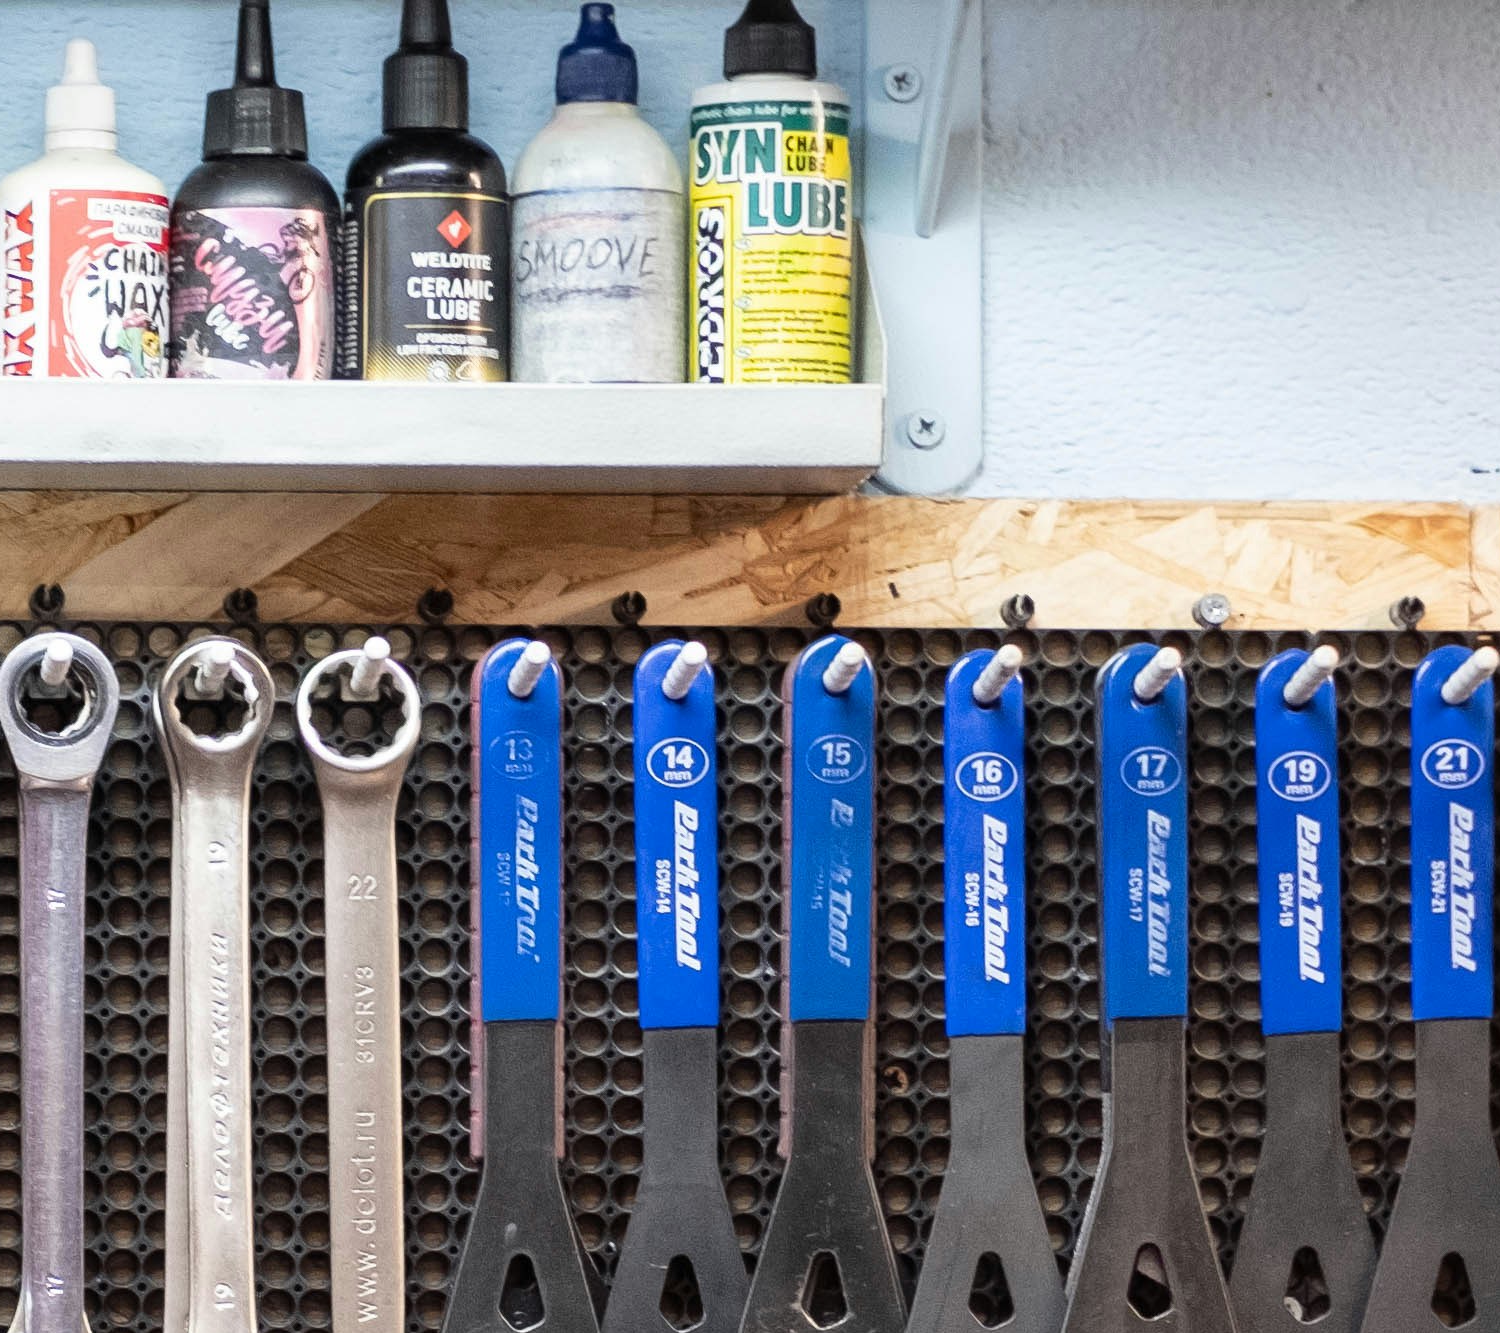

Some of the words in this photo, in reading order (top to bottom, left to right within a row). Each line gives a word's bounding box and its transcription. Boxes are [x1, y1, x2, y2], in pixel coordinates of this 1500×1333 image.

[695, 124, 778, 186] SYN
[785, 135, 834, 154] CHAN
[786, 155, 827, 172] LUBE
[743, 180, 848, 237] LUBE
[410, 251, 492, 271] WELDTITE
[516, 234, 660, 283] SMOOVE
[406, 276, 494, 302] CERAMIC
[105, 278, 165, 327] WAX
[426, 299, 481, 321] LUBE
[662, 745, 695, 769] 14
[821, 741, 851, 765] 15
[1435, 746, 1469, 770] 21
[663, 770, 692, 782] mm
[821, 767, 850, 778] mm
[970, 759, 1003, 783] 16
[1136, 754, 1168, 777] 17
[1283, 758, 1317, 783] 19
[1439, 772, 1468, 782] mm
[972, 784, 1001, 796] mm
[1136, 780, 1165, 790] mm
[1285, 784, 1313, 795] mm
[205, 840, 230, 870] 19
[347, 873, 379, 900] 22
[656, 858, 672, 914] SCW-14
[1128, 867, 1143, 922] SCW-17
[1430, 860, 1447, 914] SCW-21
[45, 887, 66, 911] 17
[964, 872, 980, 926] SCW-16
[1278, 872, 1294, 927] SCW-19
[353, 963, 377, 1065] 31CRV3
[353, 1108, 380, 1324] www.delot.ru
[45, 1274, 65, 1297] 17
[213, 1282, 236, 1312] 19
